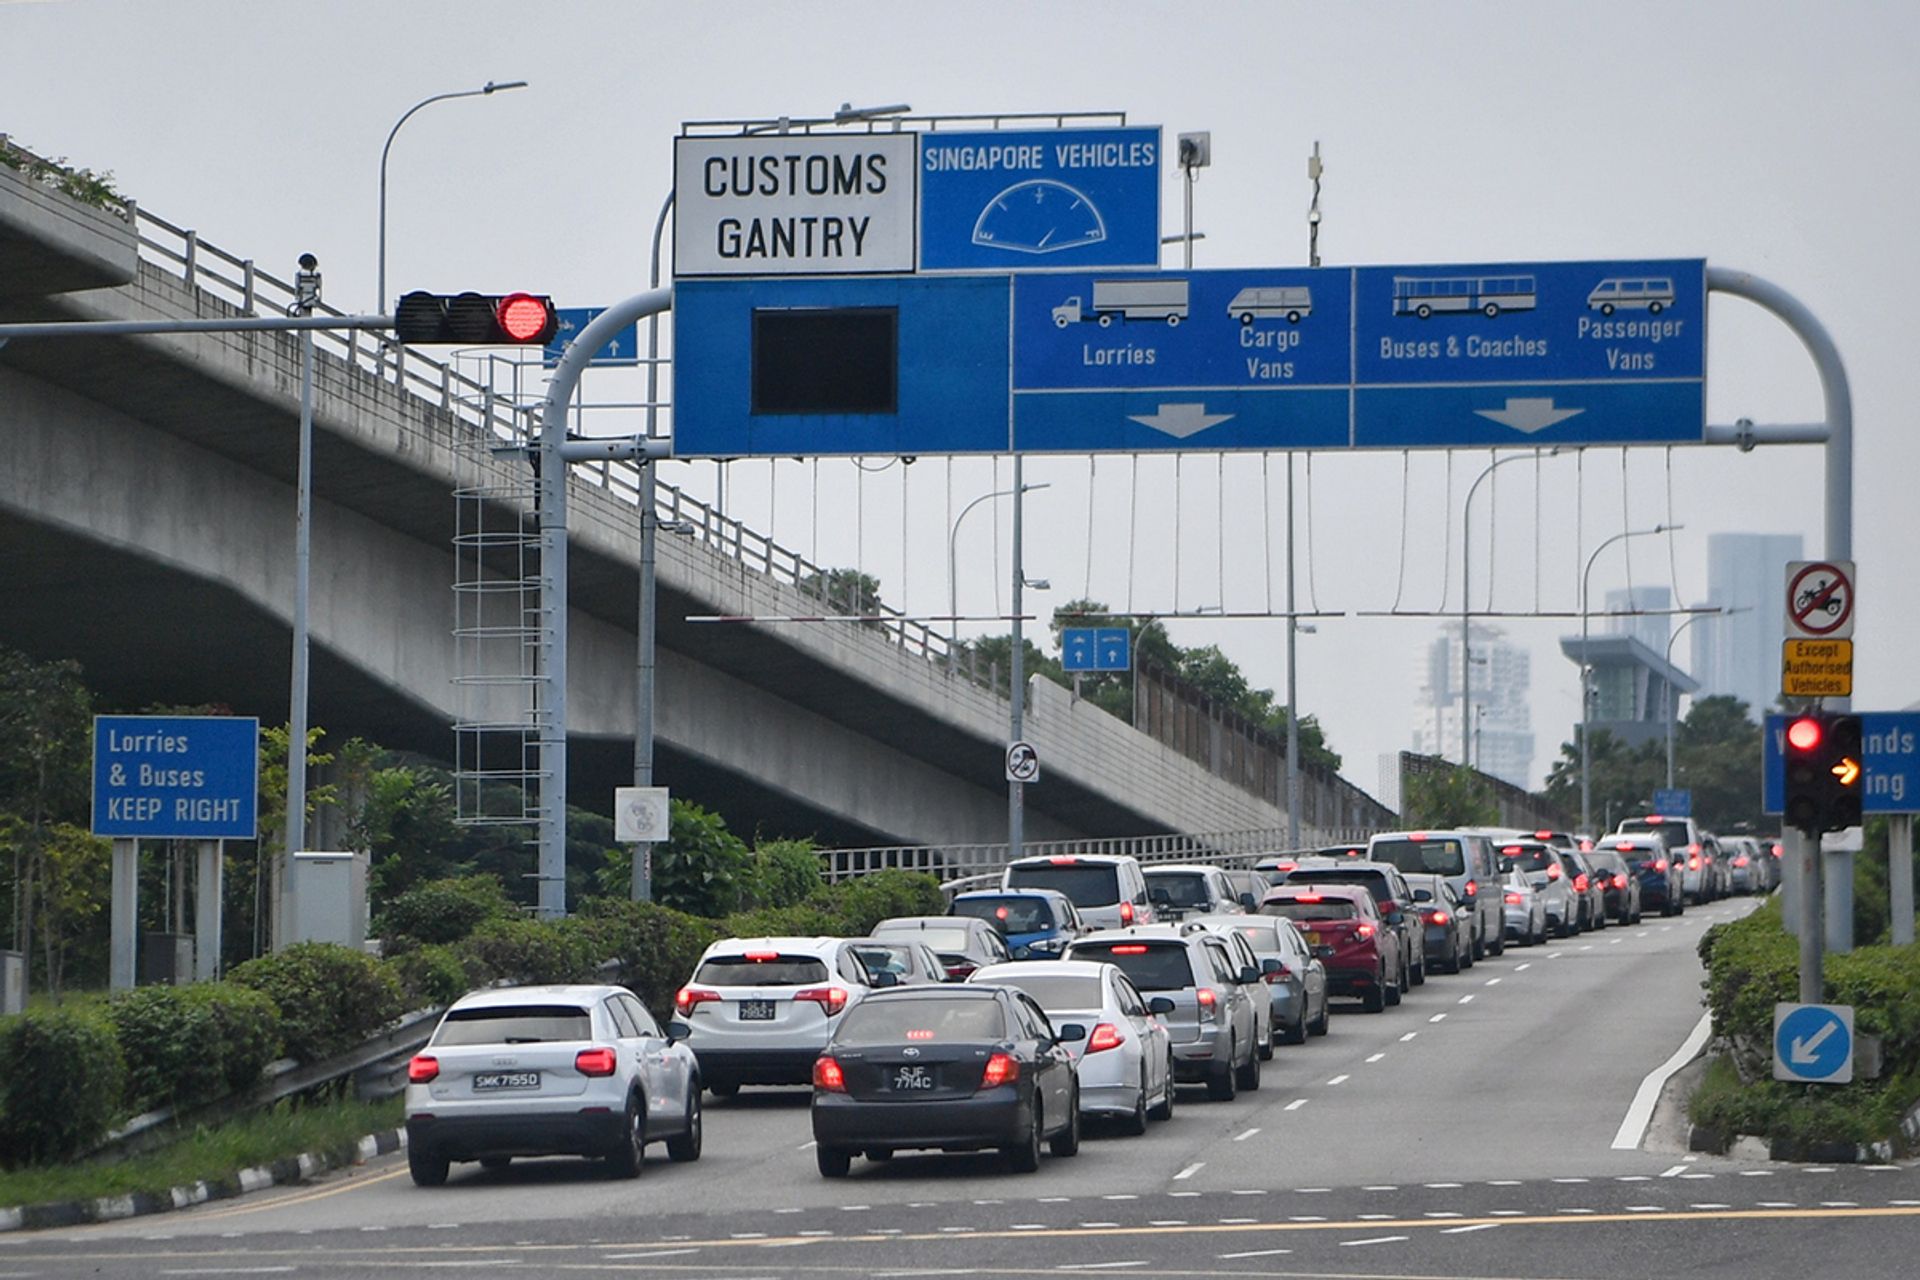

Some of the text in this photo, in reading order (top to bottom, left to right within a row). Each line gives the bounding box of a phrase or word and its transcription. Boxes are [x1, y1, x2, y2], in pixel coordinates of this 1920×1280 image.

[925, 143, 1155, 171] SINGAPORE VEHICLES
[704, 154, 887, 197] CUSTOMS
[718, 216, 870, 258] GANTRY
[1240, 327, 1300, 352] Cargo
[1578, 316, 1682, 342] Passenger
[1083, 343, 1156, 366] Lorries
[1380, 334, 1547, 359] Buses & Coaches
[1247, 357, 1294, 379] Vans
[1606, 348, 1654, 370] Vans
[1796, 642, 1838, 658] Except
[1784, 659, 1850, 675] Authorised
[1791, 677, 1842, 693] Vehicles
[109, 729, 188, 753] Lorries
[109, 763, 204, 787] & Buses
[108, 797, 240, 822] KEEP RIGHT
[893, 1077, 932, 1089] 7714C
[899, 1066, 925, 1079] SJF
